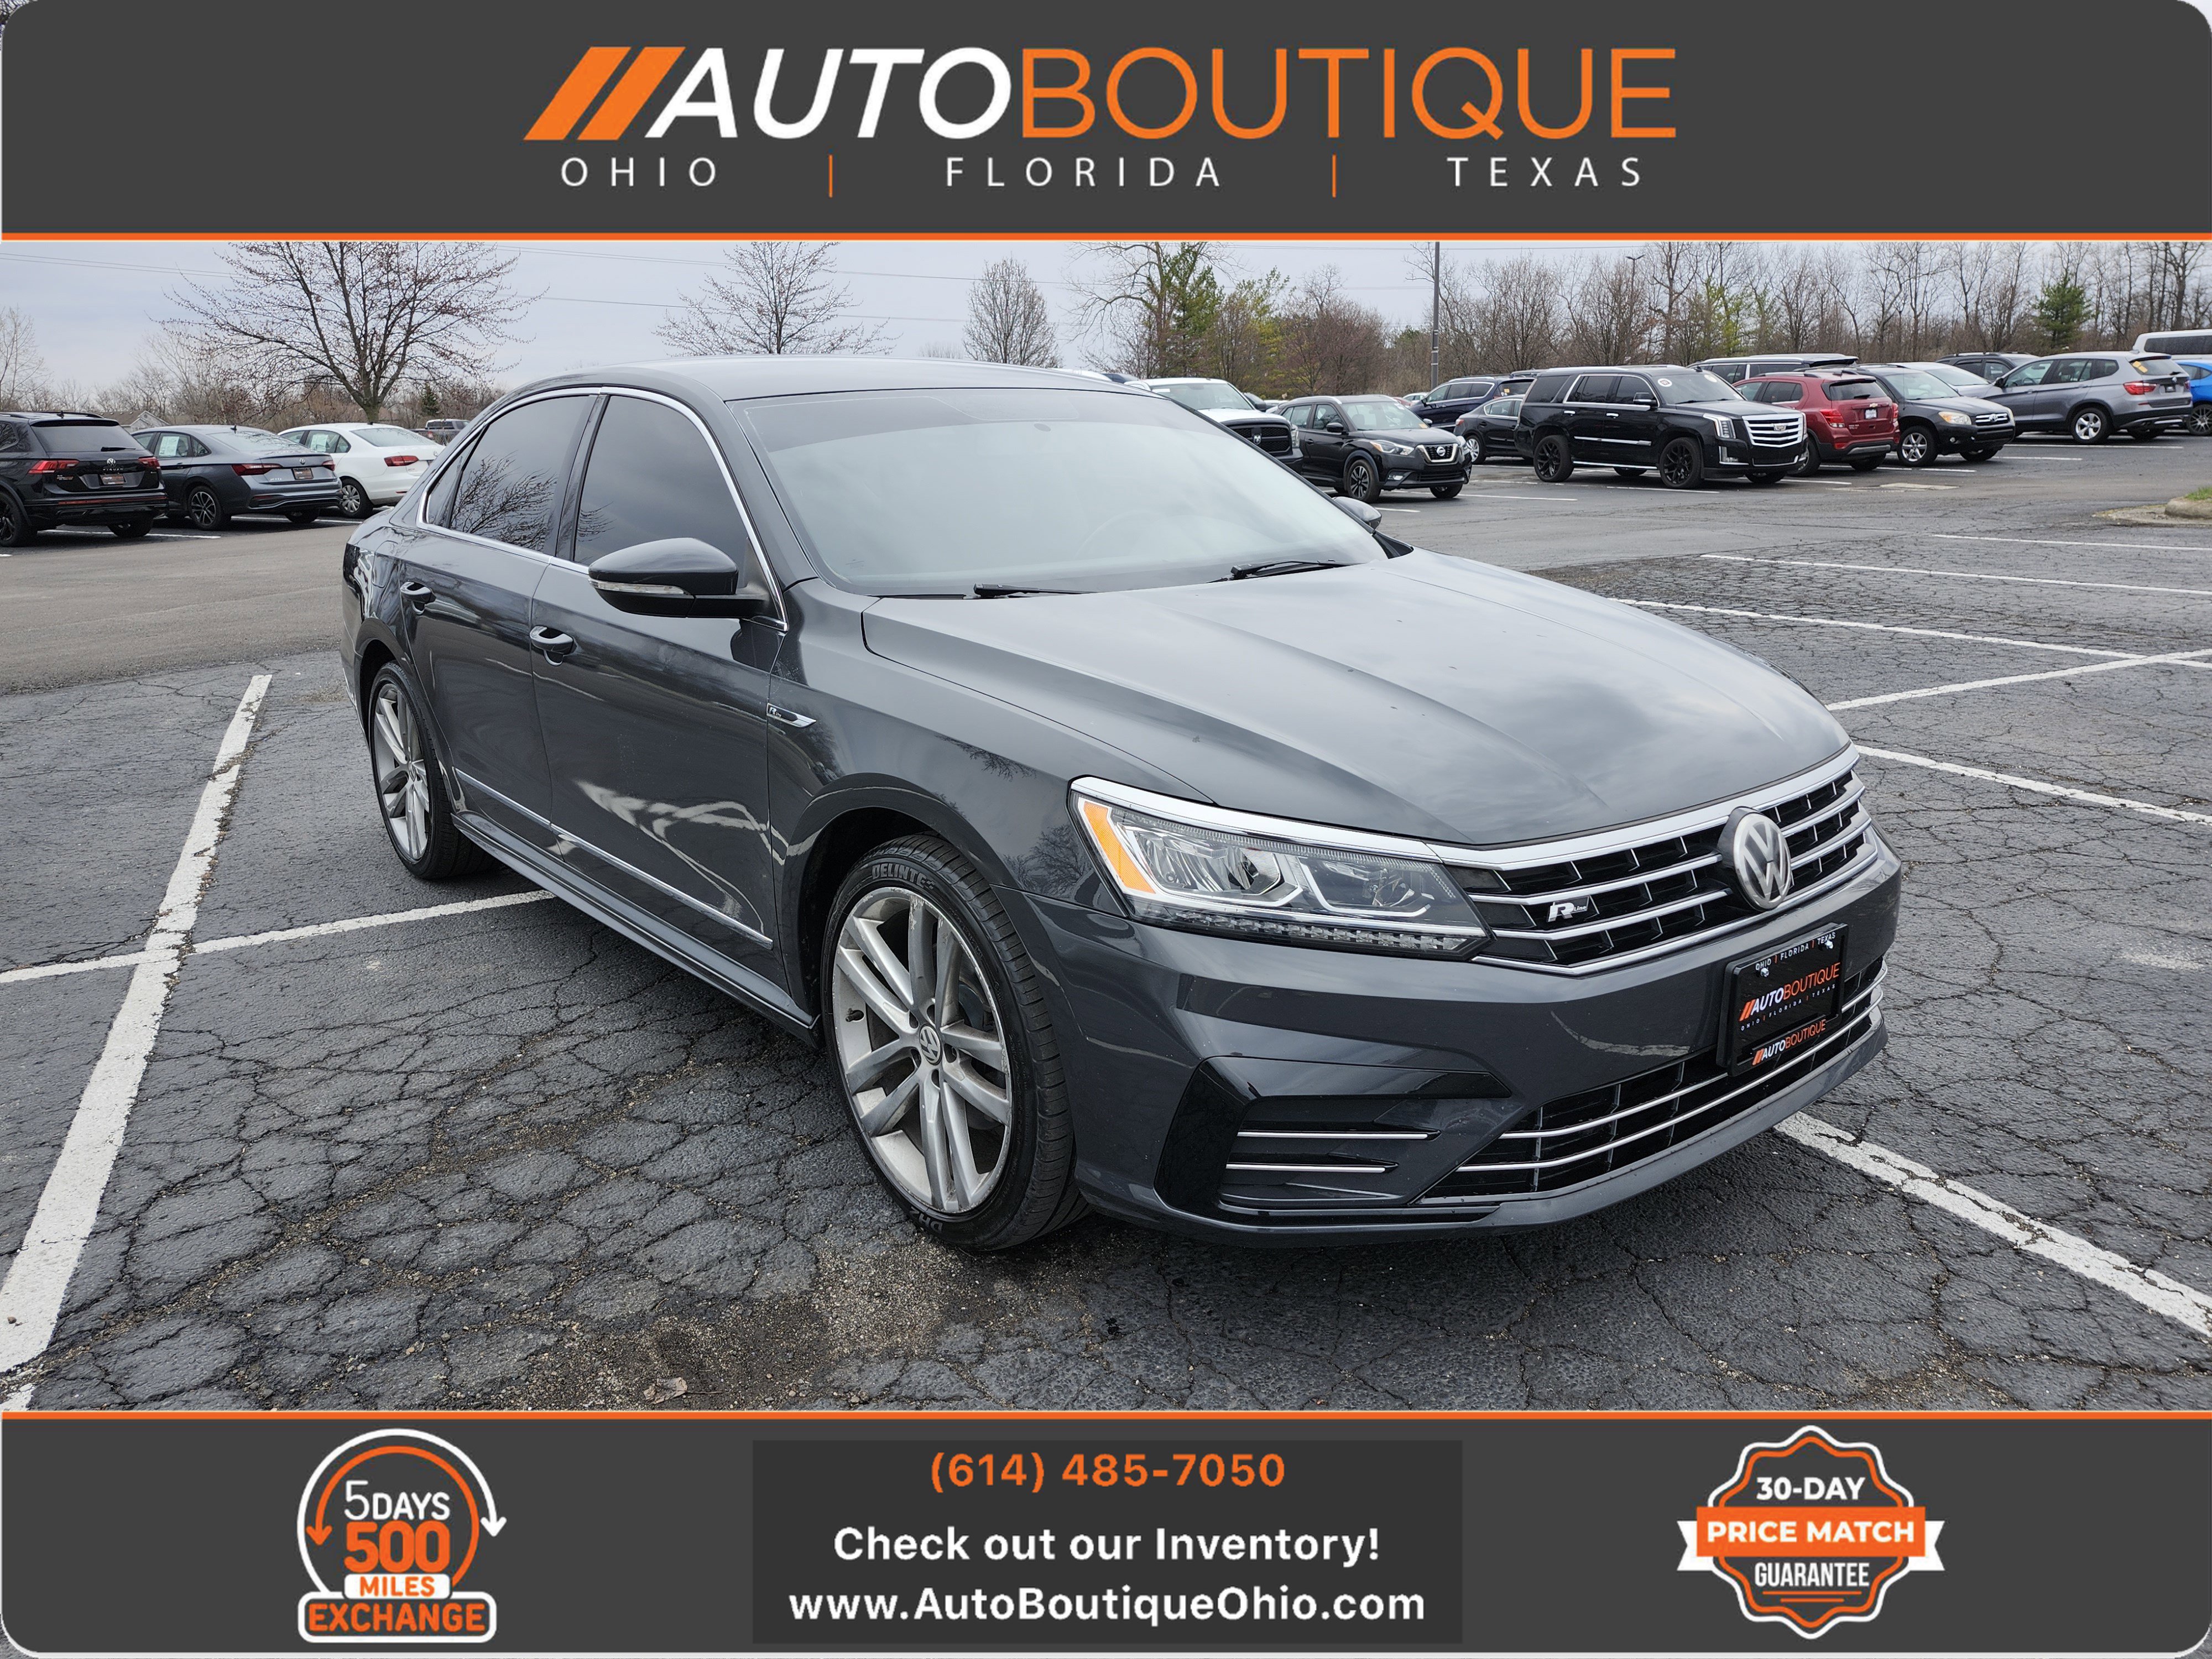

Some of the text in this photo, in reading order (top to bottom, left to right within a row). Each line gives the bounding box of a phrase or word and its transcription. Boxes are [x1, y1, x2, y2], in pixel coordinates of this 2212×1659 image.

[1755, 931, 1836, 971] OHIO FLORIDA TEXAS
[1741, 984, 1835, 1031] OHIO FLORIDA TEXAS
[1750, 962, 1841, 1016] AUTOBOUTIQUE
